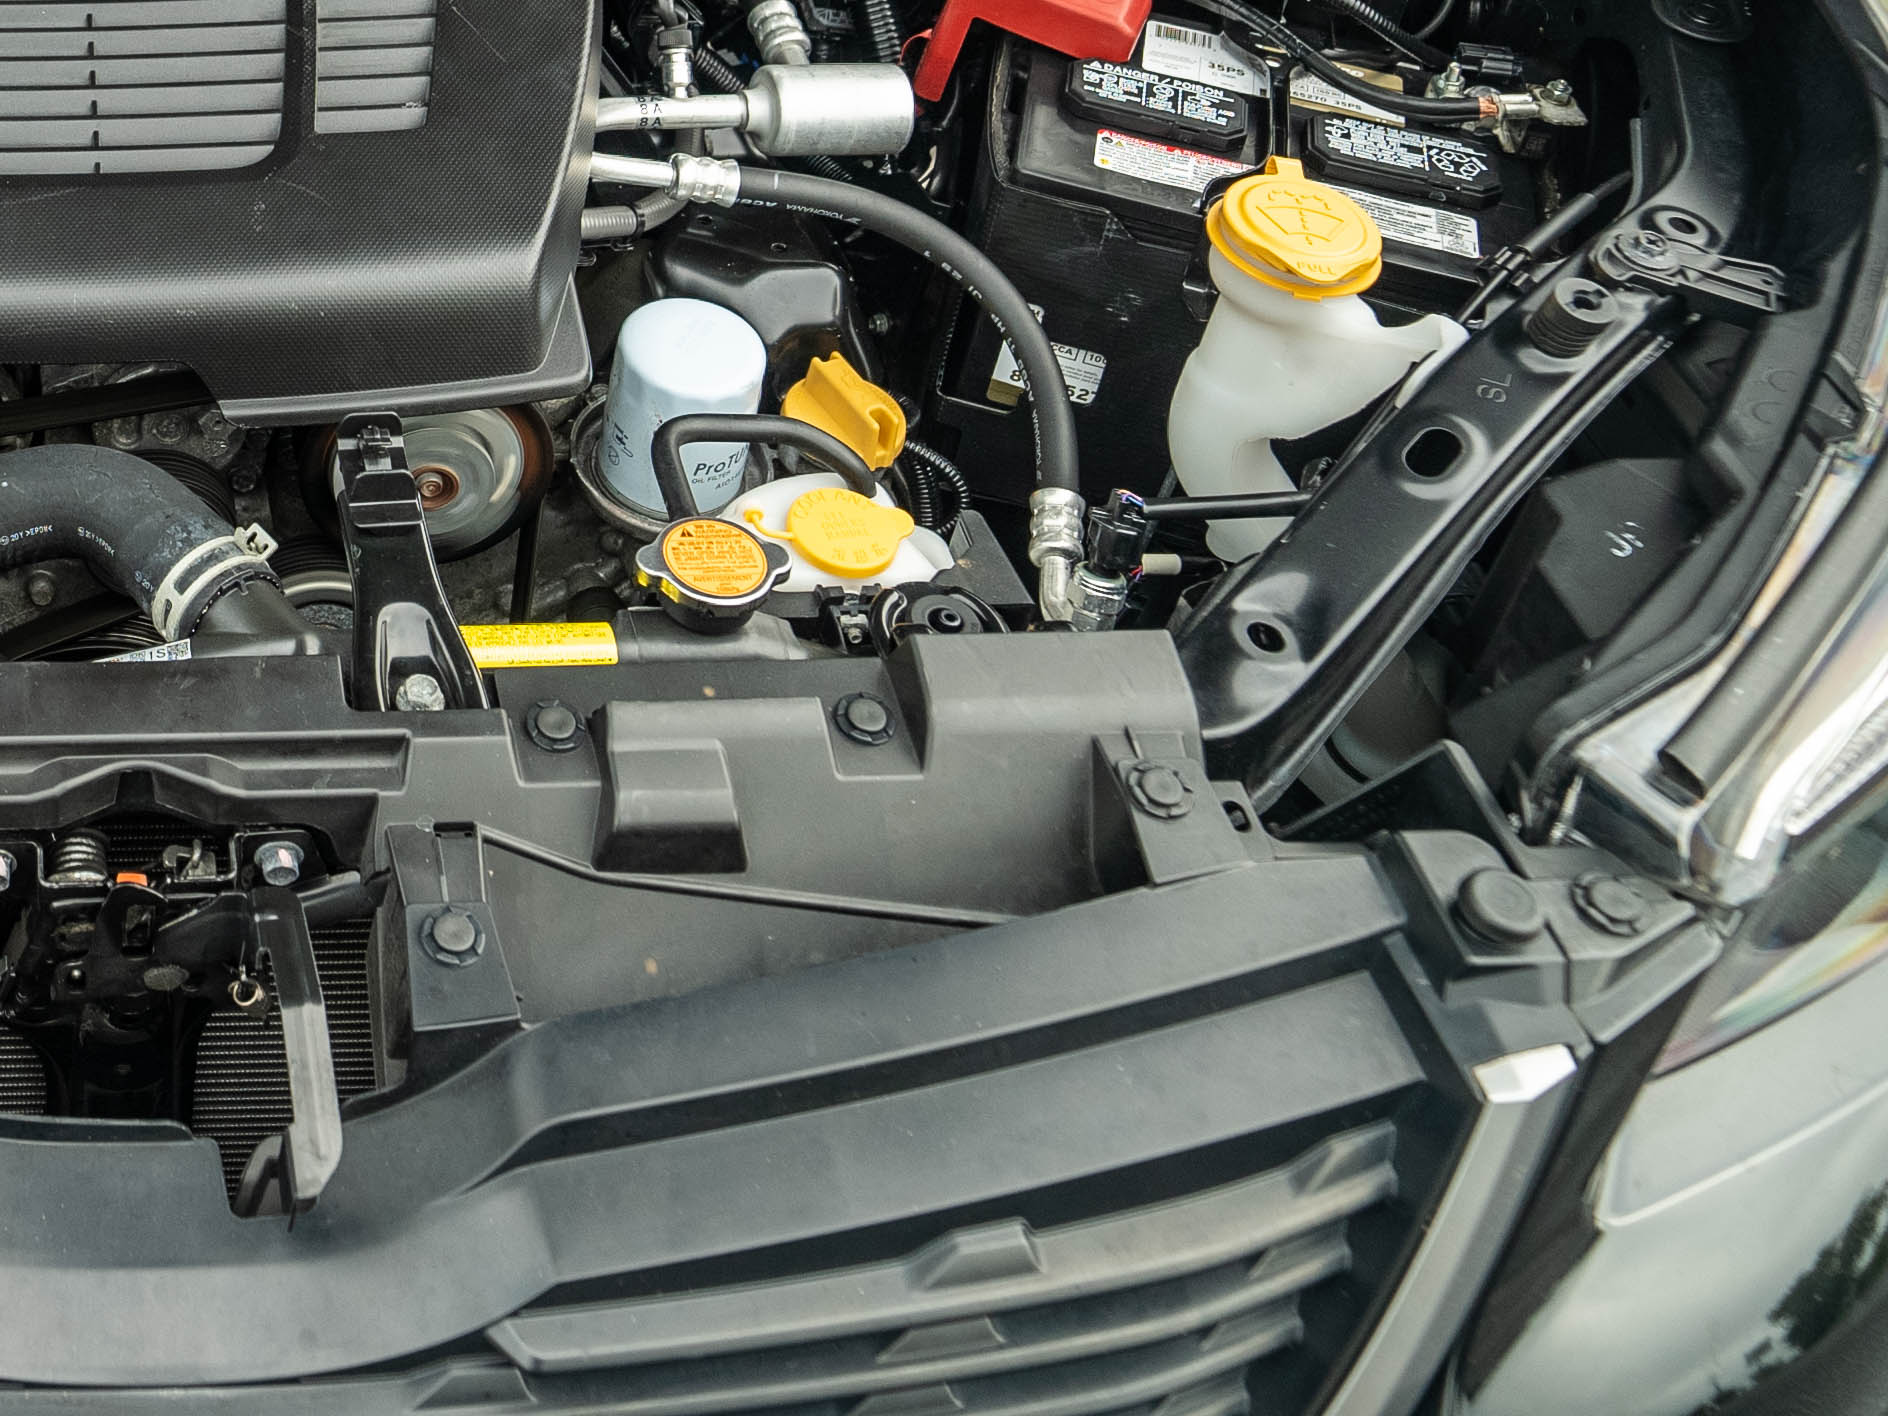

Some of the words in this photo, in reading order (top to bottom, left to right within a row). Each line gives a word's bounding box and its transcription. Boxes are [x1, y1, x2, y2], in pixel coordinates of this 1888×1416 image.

[1103, 62, 1159, 83] DANGER
[1173, 79, 1224, 97] POISON
[1476, 373, 1513, 403] SL
